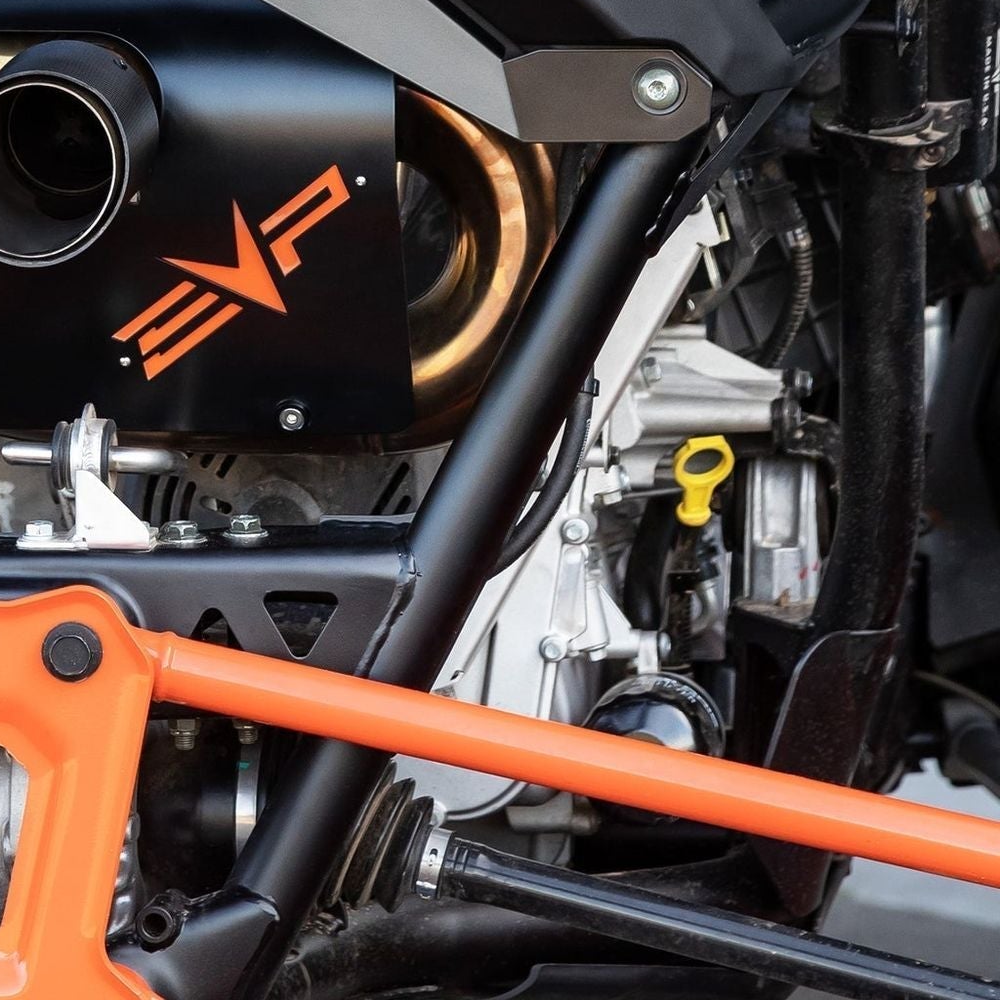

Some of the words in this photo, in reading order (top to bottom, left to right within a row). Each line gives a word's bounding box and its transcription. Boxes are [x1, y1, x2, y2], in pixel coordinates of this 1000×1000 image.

[984, 35, 993, 73] MADE
[983, 75, 991, 90] IN
[112, 164, 350, 381] EVP
